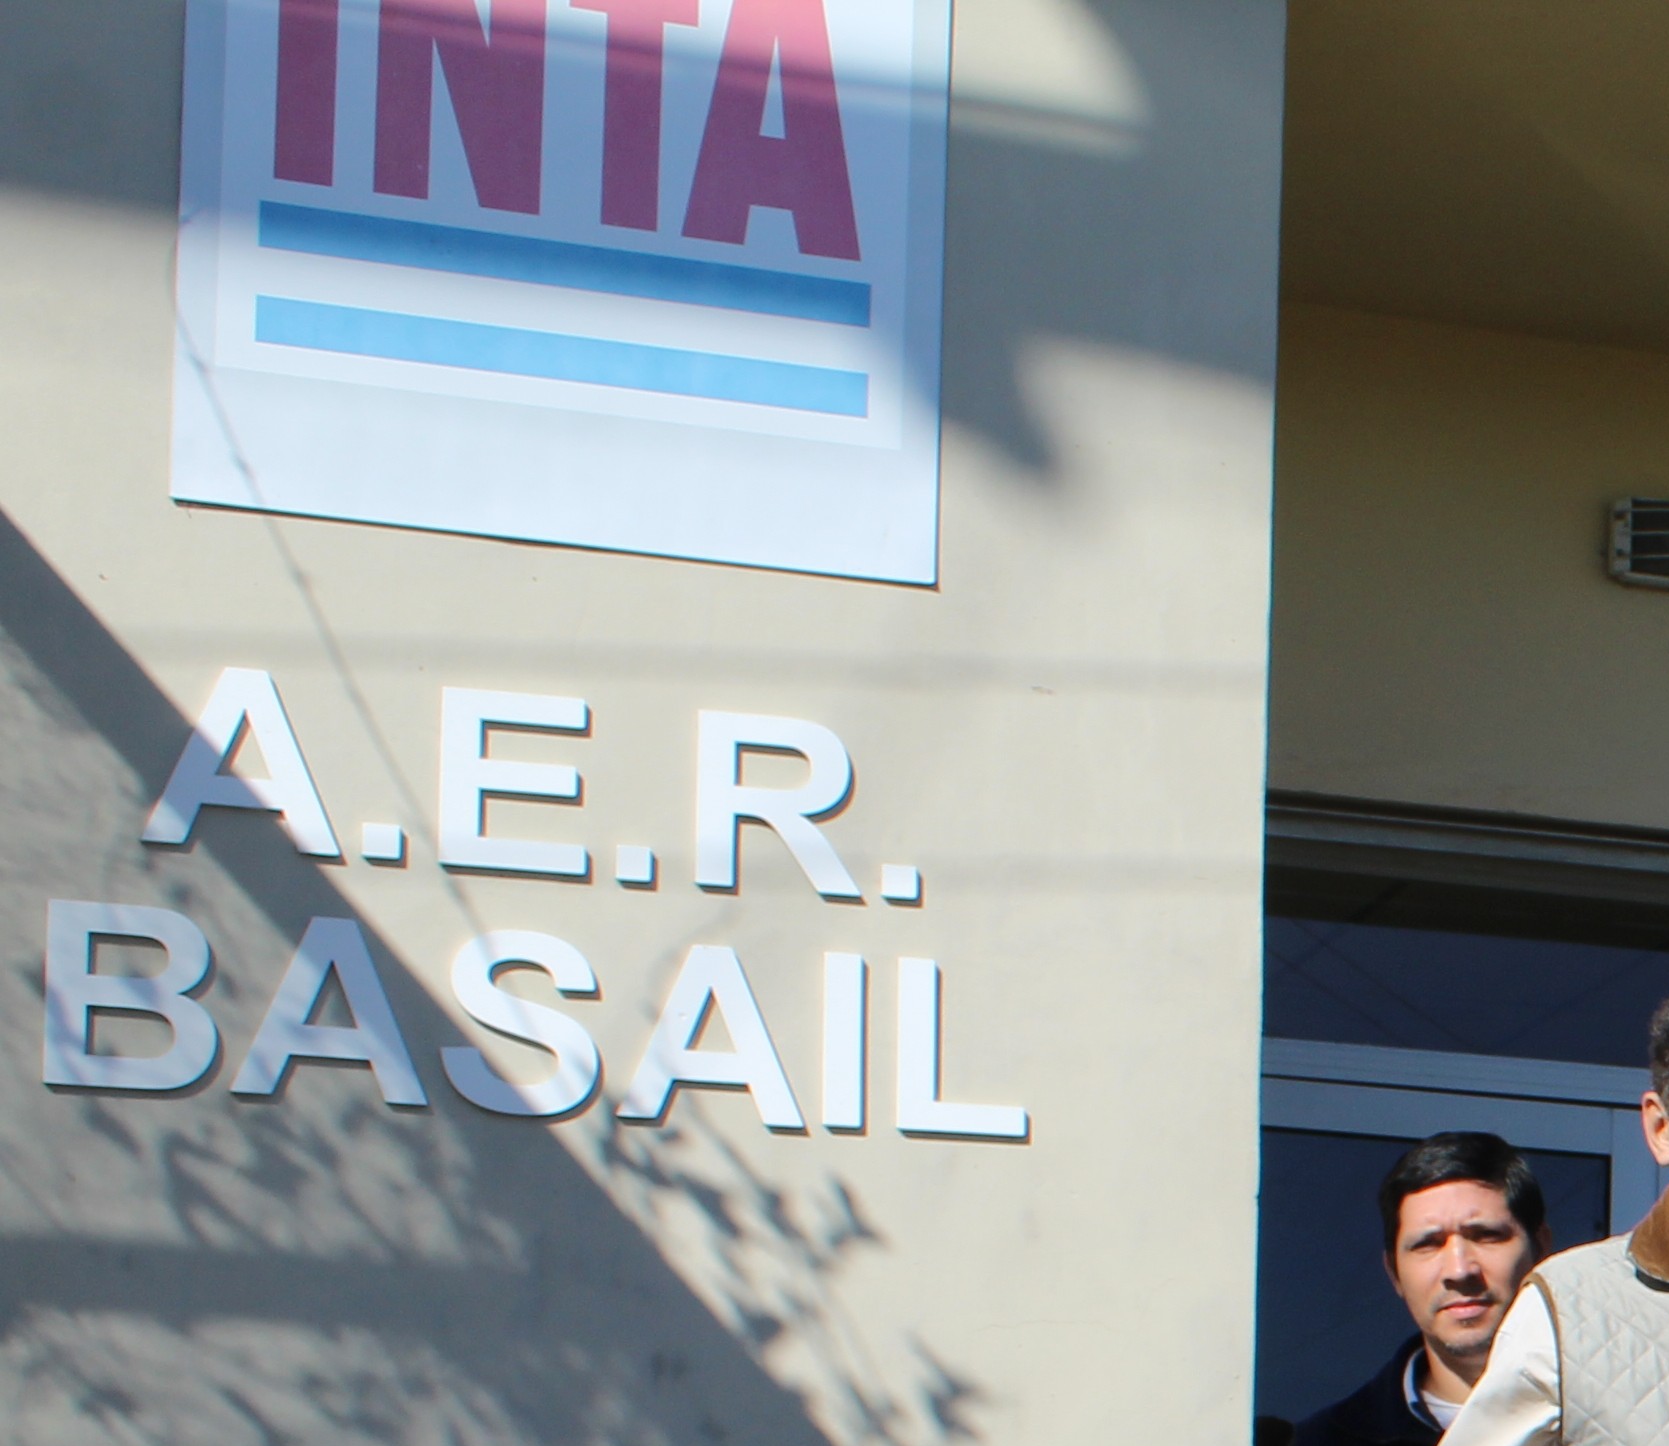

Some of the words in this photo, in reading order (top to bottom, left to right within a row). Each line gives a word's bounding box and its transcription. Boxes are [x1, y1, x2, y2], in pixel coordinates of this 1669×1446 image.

[274, 0, 861, 262] INTA
[140, 666, 923, 902] A.E.R.
[42, 898, 1029, 1138] BASAIL
